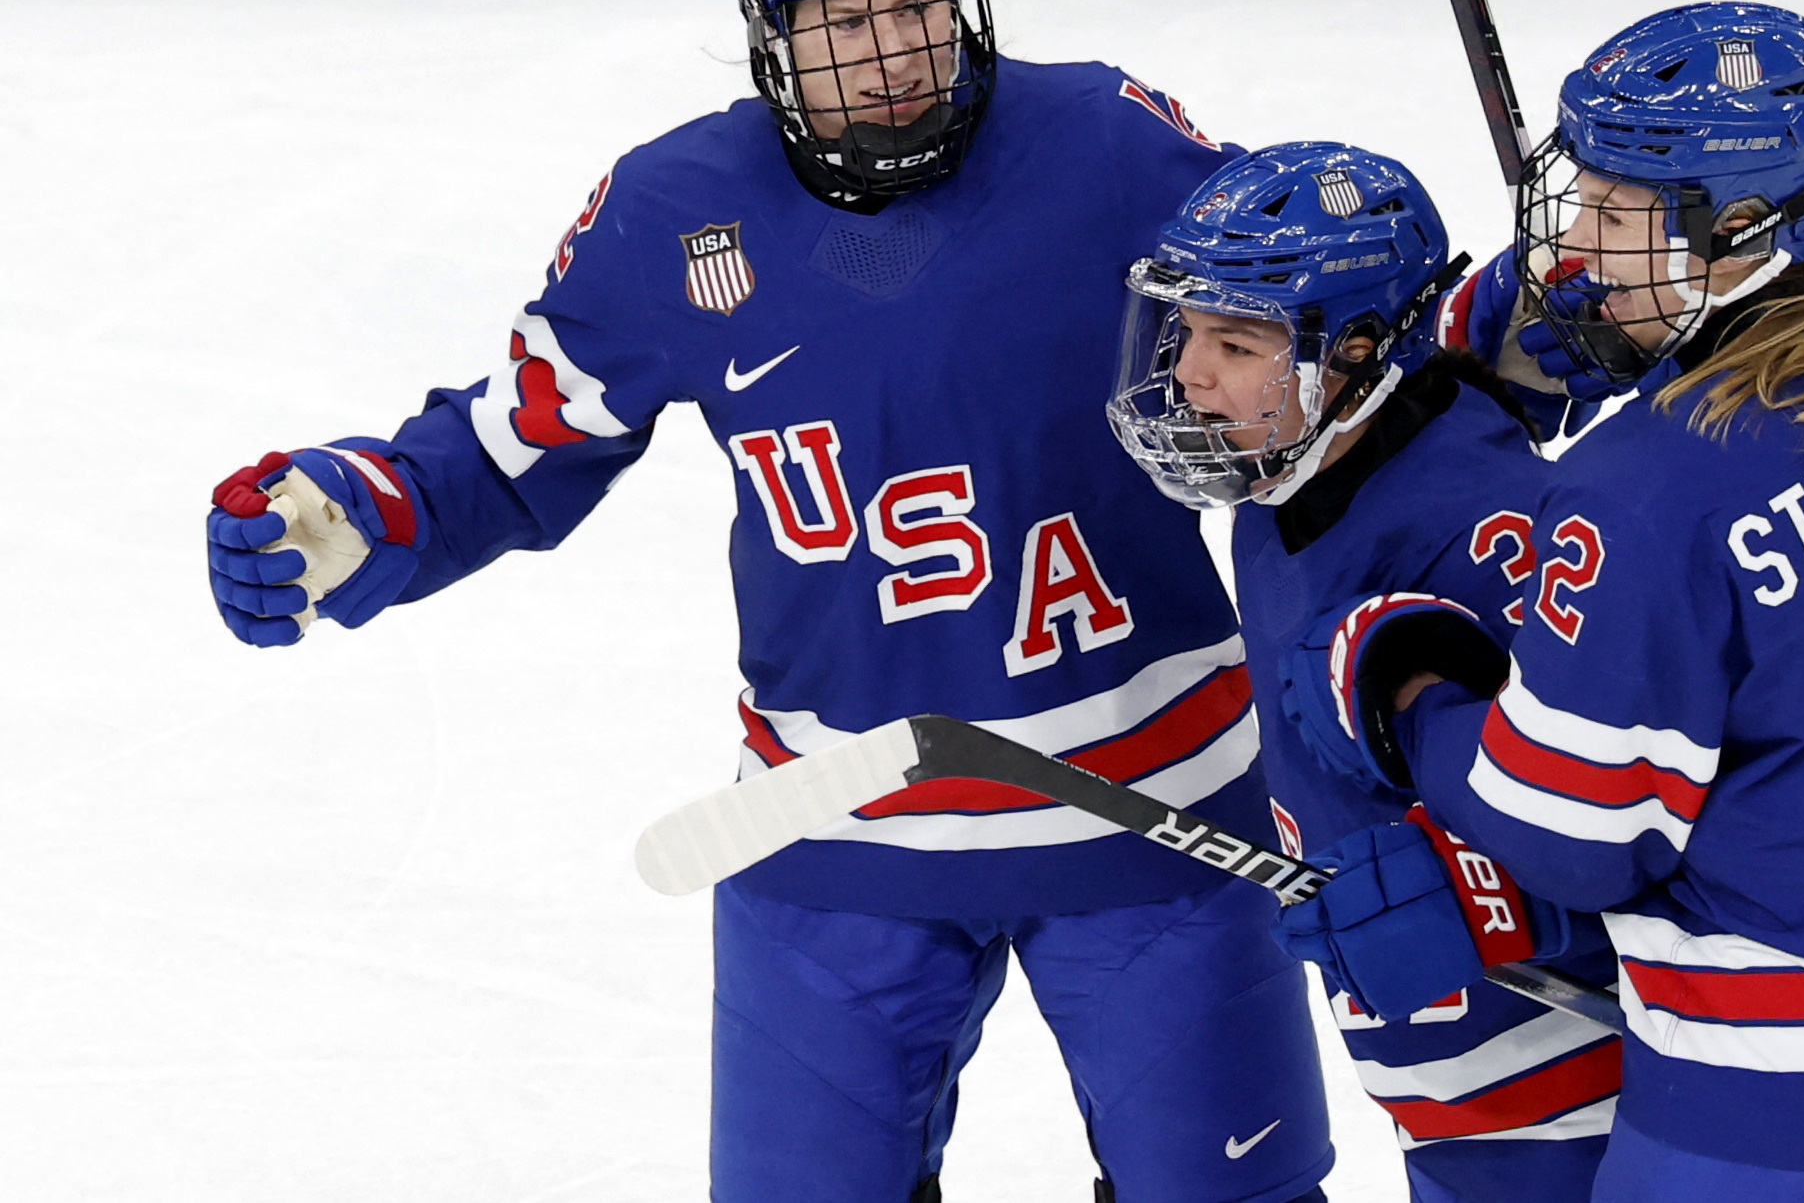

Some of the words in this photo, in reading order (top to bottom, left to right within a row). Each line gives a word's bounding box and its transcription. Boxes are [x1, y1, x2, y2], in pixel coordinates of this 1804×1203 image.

[1723, 42, 1750, 54] USA
[1702, 136, 1782, 152] BAUER
[874, 144, 945, 171] CCM
[1320, 171, 1346, 185] USA
[691, 231, 732, 256] USA
[728, 420, 1136, 678] USA
[1534, 514, 1606, 646] 2
